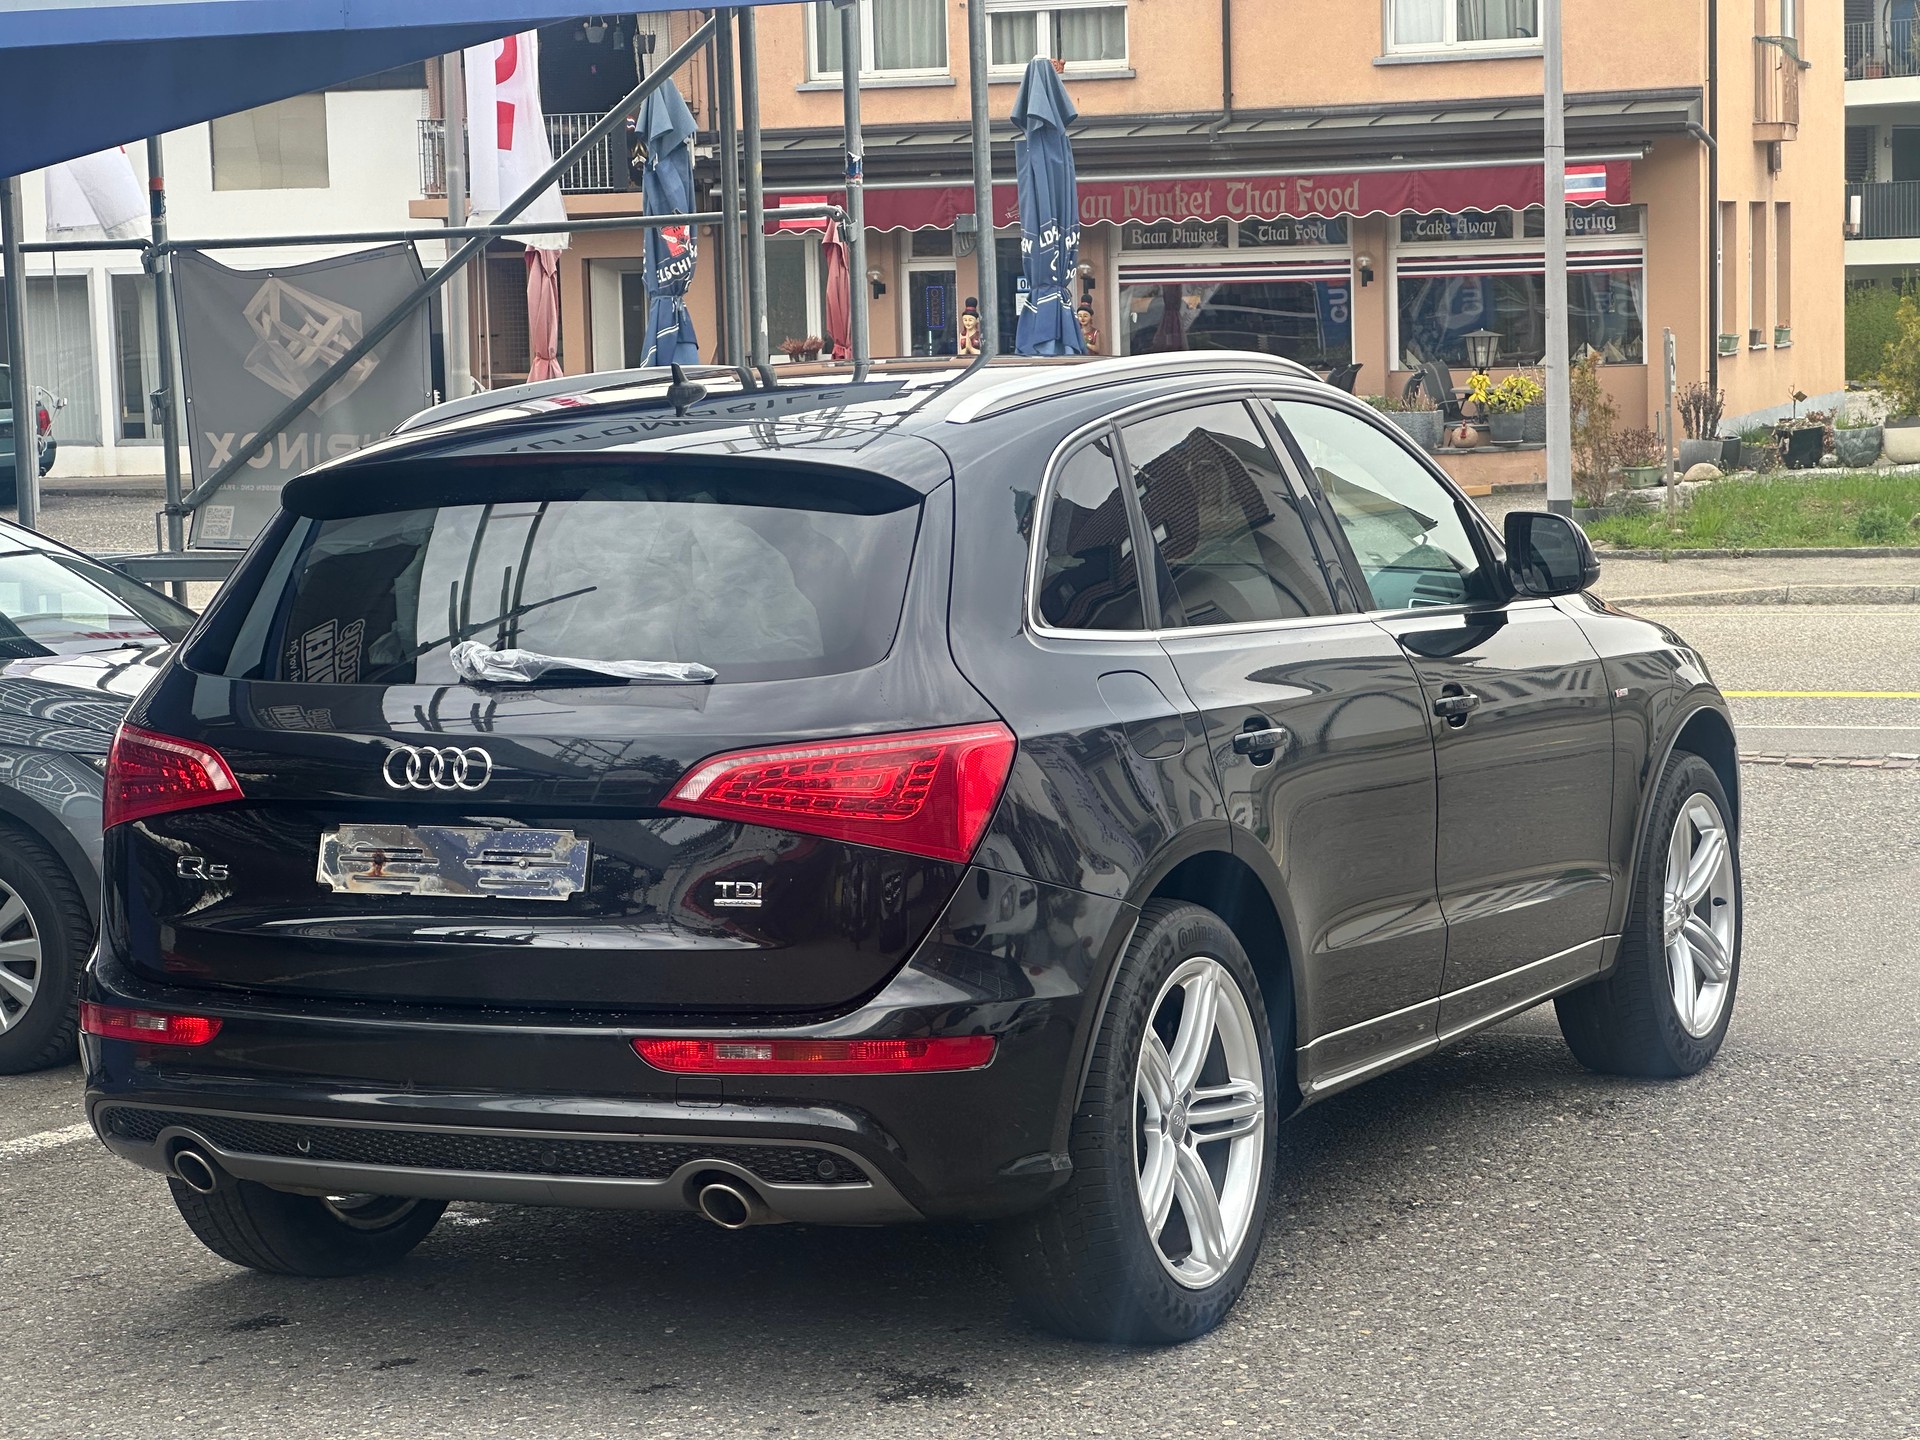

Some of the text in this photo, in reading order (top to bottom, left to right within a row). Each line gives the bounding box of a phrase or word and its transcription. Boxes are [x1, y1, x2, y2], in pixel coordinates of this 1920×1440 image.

[1123, 183, 1212, 218] Phuket
[1226, 182, 1286, 214] Thai
[1295, 178, 1360, 212] Food
[1132, 223, 1327, 245] Baan Phuket Thai Food
[1416, 213, 1617, 236] Take Away tering
[177, 855, 229, 880] Q5
[714, 881, 762, 898] TDI
